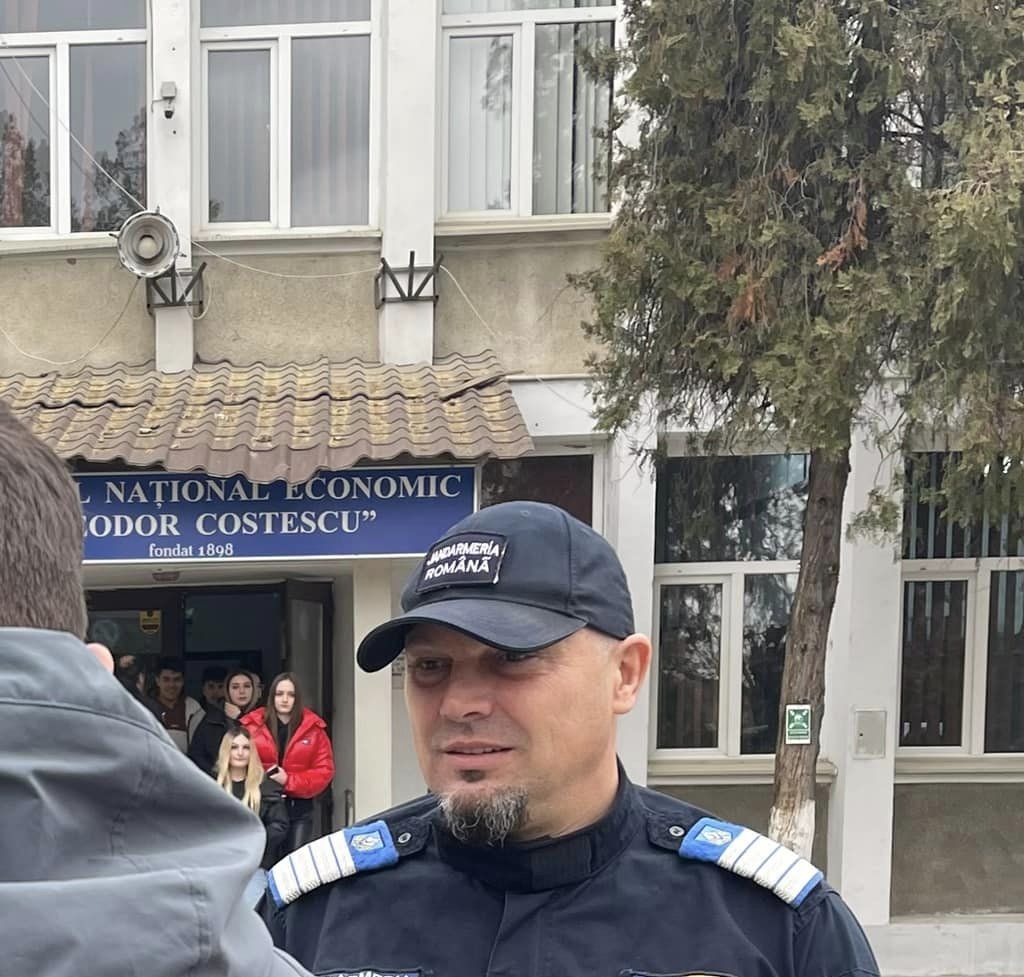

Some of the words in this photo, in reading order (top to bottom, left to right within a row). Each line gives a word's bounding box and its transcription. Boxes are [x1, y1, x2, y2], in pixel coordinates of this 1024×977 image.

[105, 479, 270, 510] NAȚIONAL
[285, 474, 462, 500] ECONOMIC
[149, 543, 193, 558] fondat
[197, 543, 234, 557] 1898
